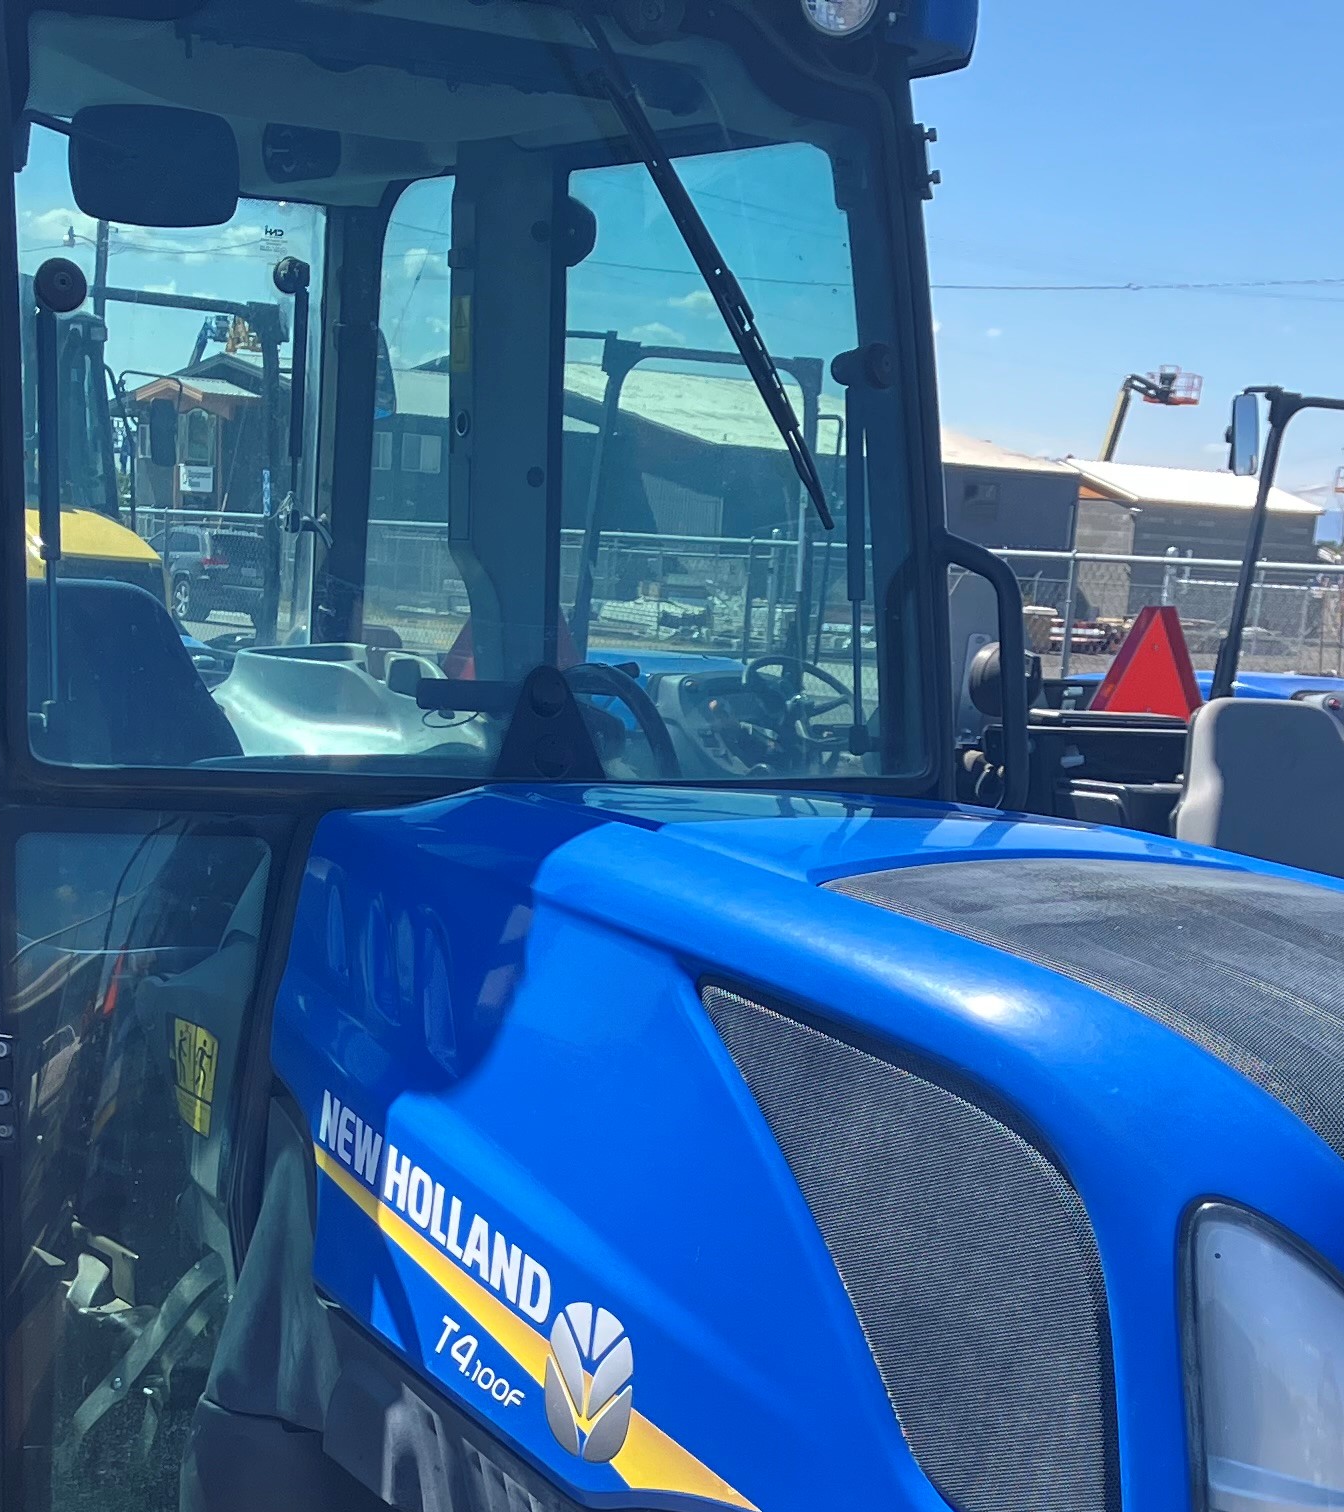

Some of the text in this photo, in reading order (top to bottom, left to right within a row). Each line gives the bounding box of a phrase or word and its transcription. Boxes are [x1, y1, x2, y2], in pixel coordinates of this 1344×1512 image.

[320, 1090, 551, 1324] NEW HOLLAND
[434, 1315, 525, 1407] T4.100F
